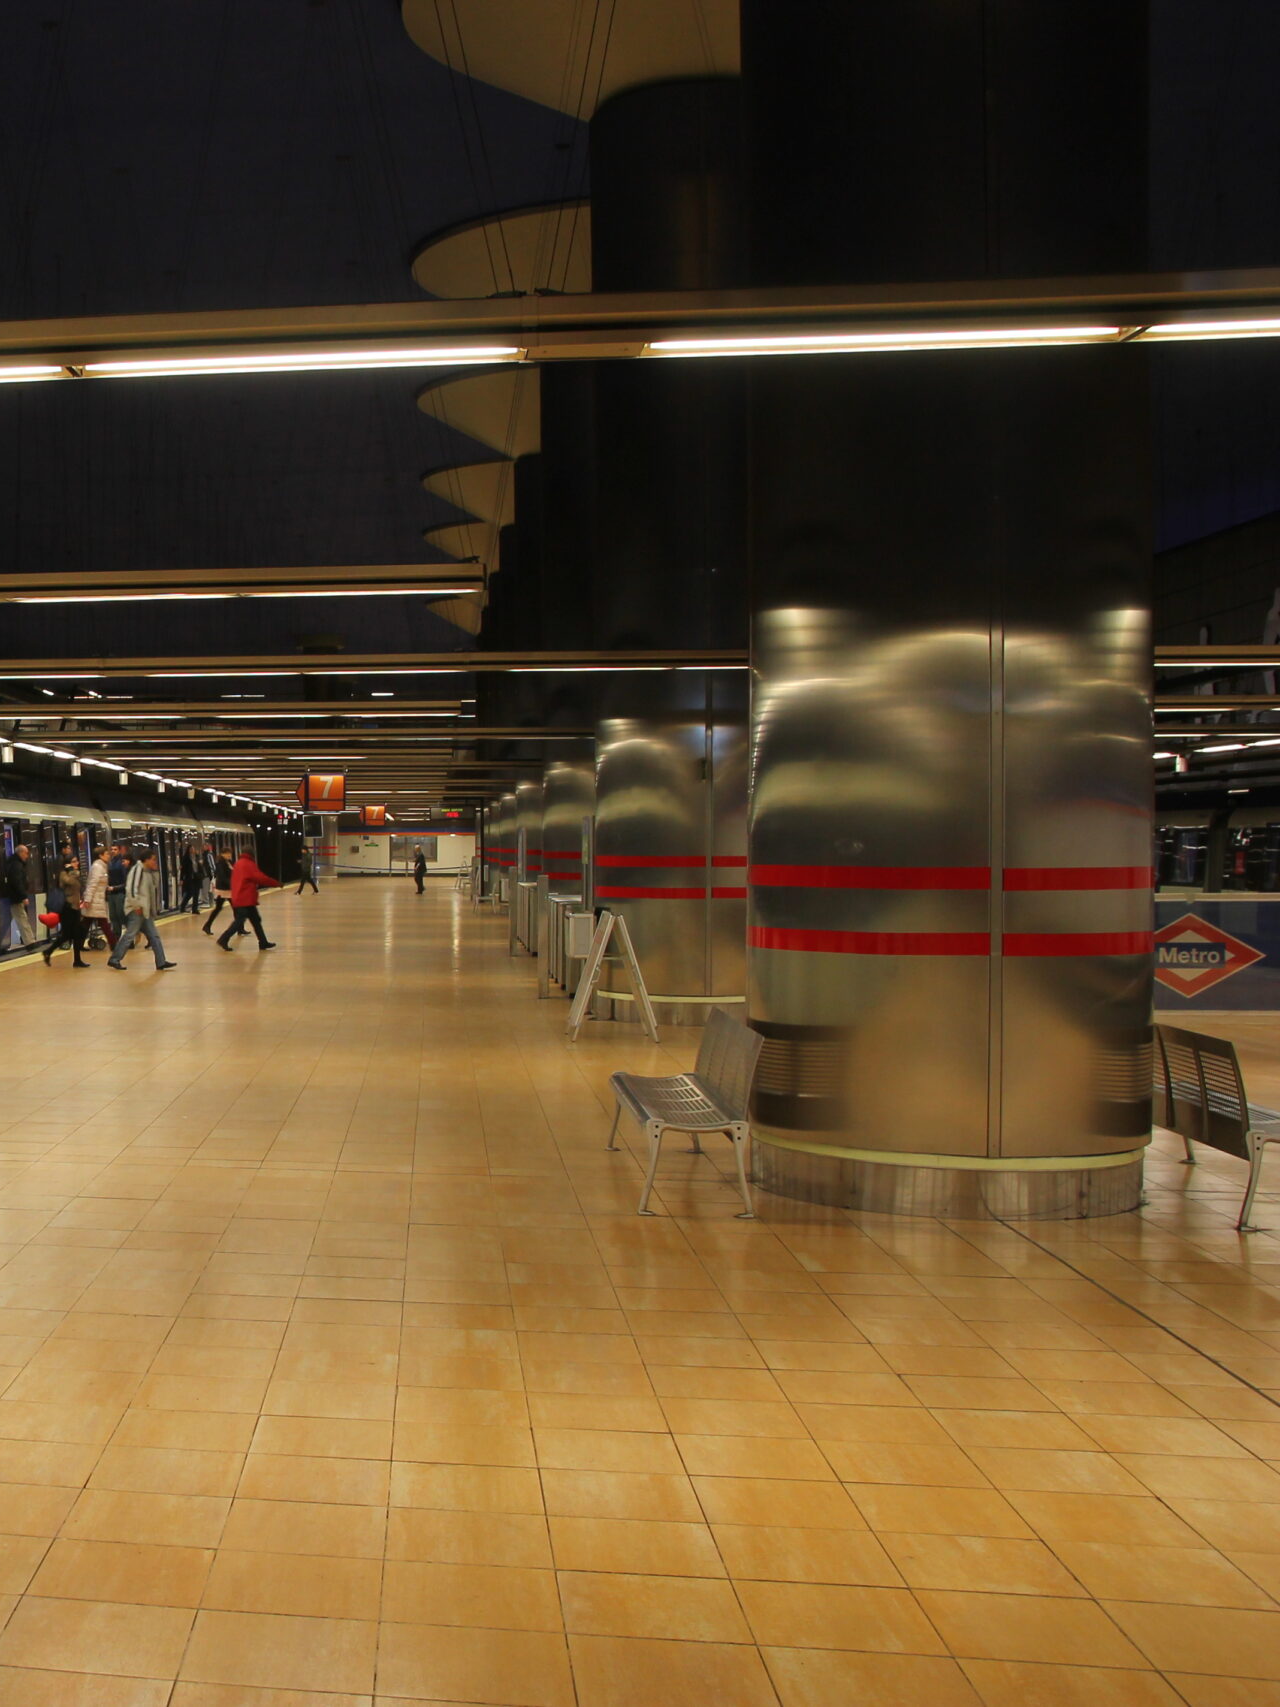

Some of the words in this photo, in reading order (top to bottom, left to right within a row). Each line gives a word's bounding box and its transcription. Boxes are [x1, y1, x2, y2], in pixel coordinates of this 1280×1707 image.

[319, 775, 334, 799] 7
[371, 807, 380, 820] 7
[1158, 947, 1220, 964] Metro
